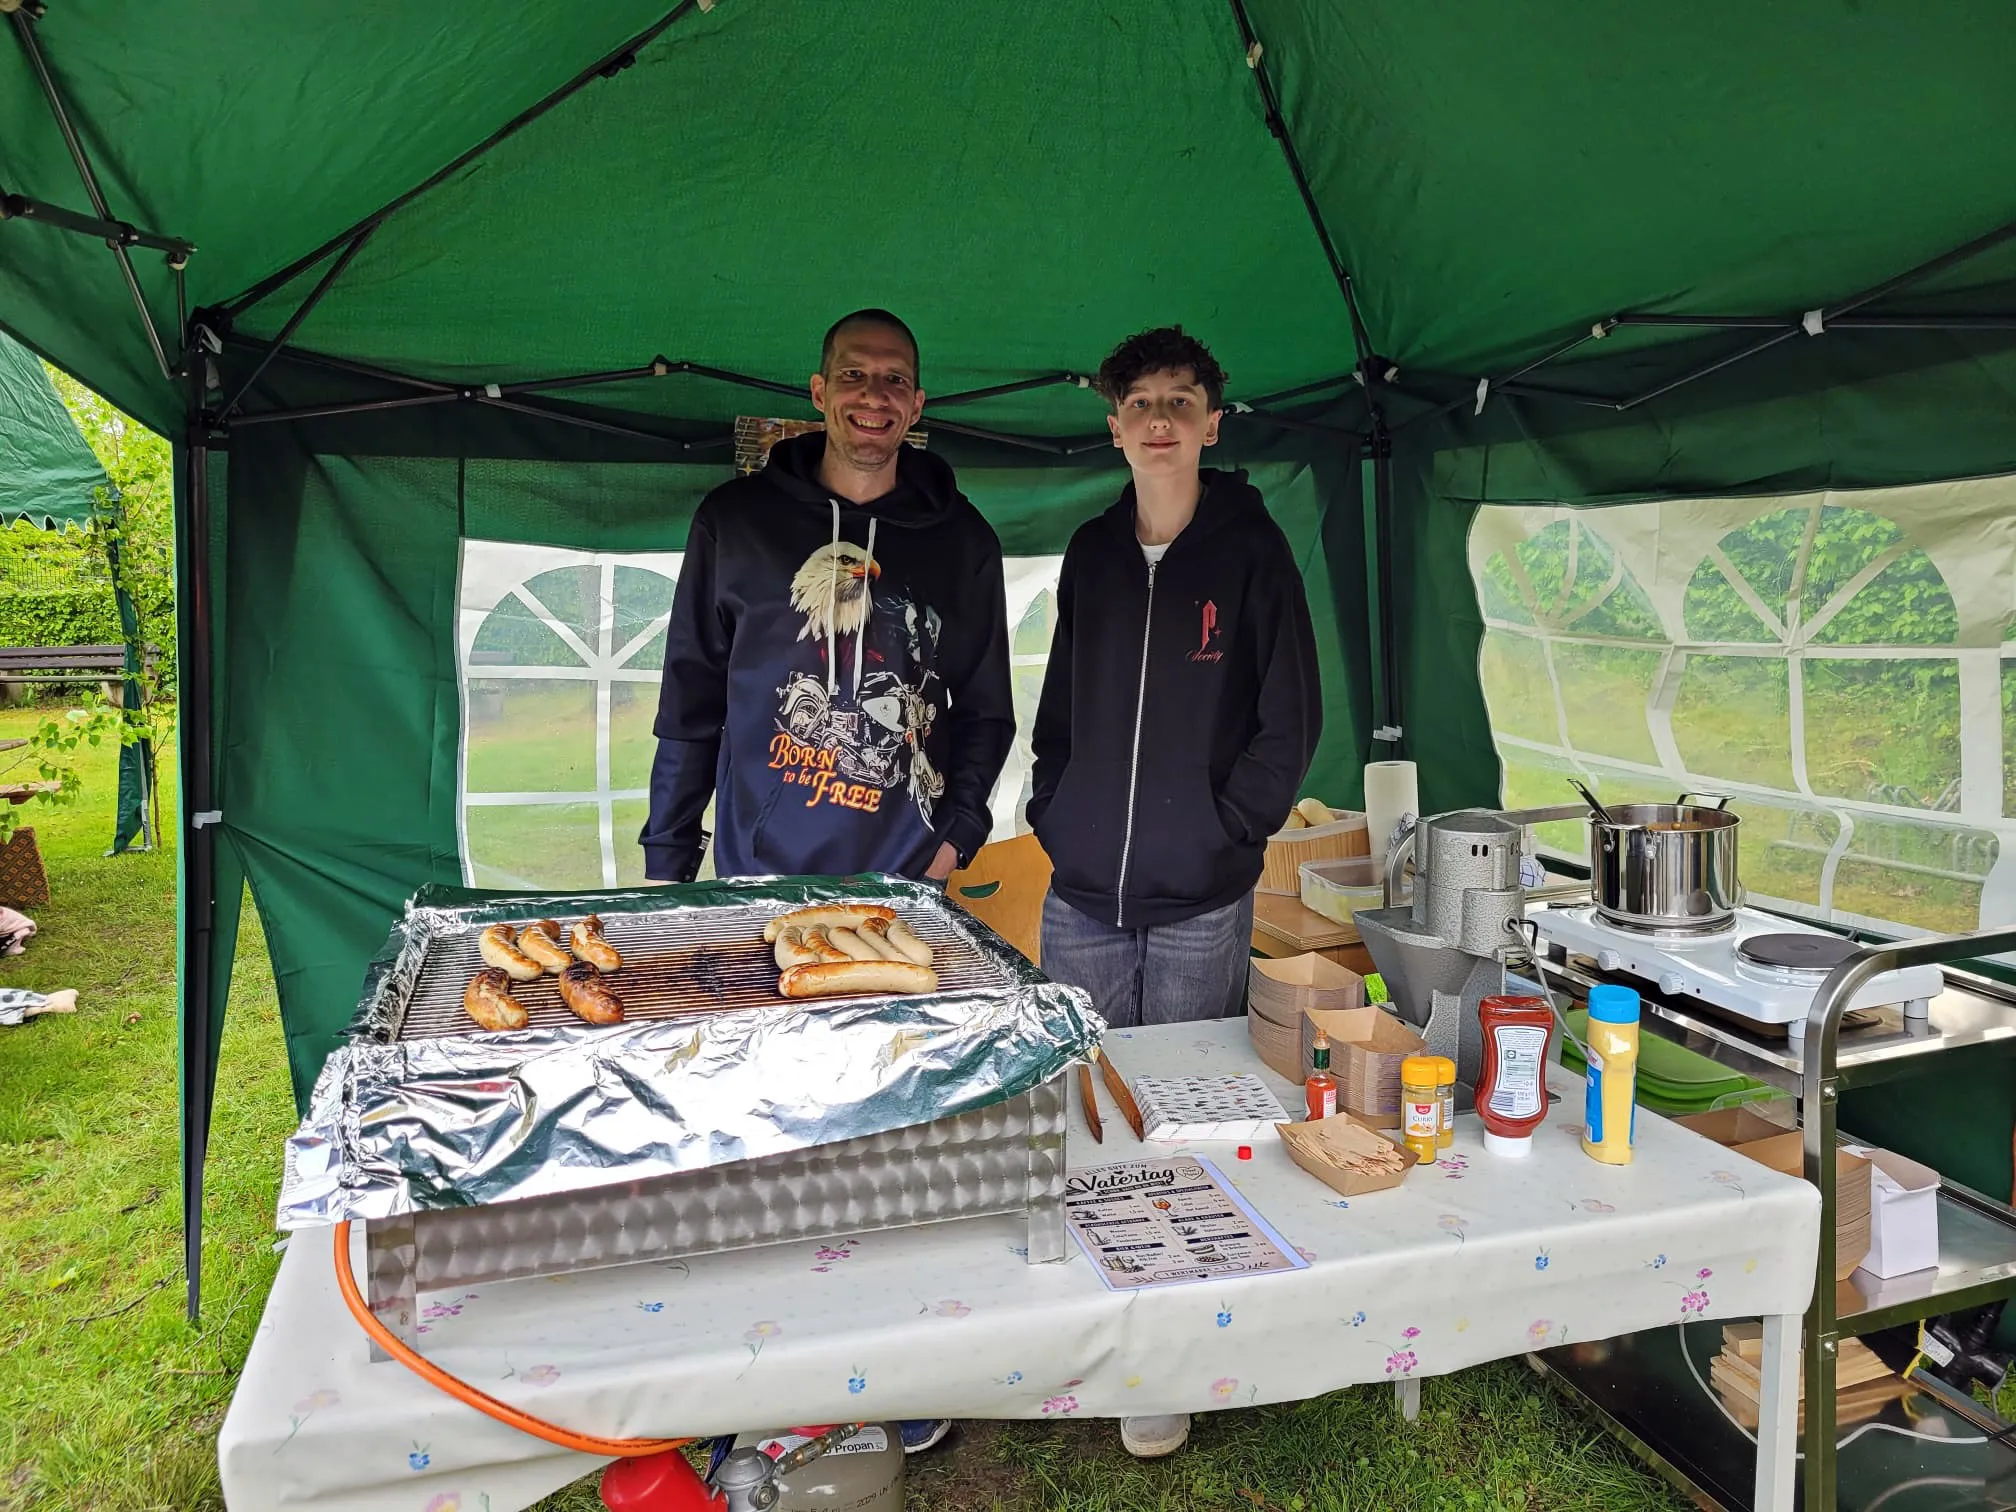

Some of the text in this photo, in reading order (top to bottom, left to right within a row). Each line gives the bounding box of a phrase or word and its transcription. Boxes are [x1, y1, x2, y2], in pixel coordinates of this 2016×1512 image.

[768, 732, 843, 772] BORN
[783, 767, 810, 784] to be
[806, 771, 883, 813] FREE
[1068, 1169, 1175, 1191] Vatertag
[835, 1441, 874, 1453] Propan
